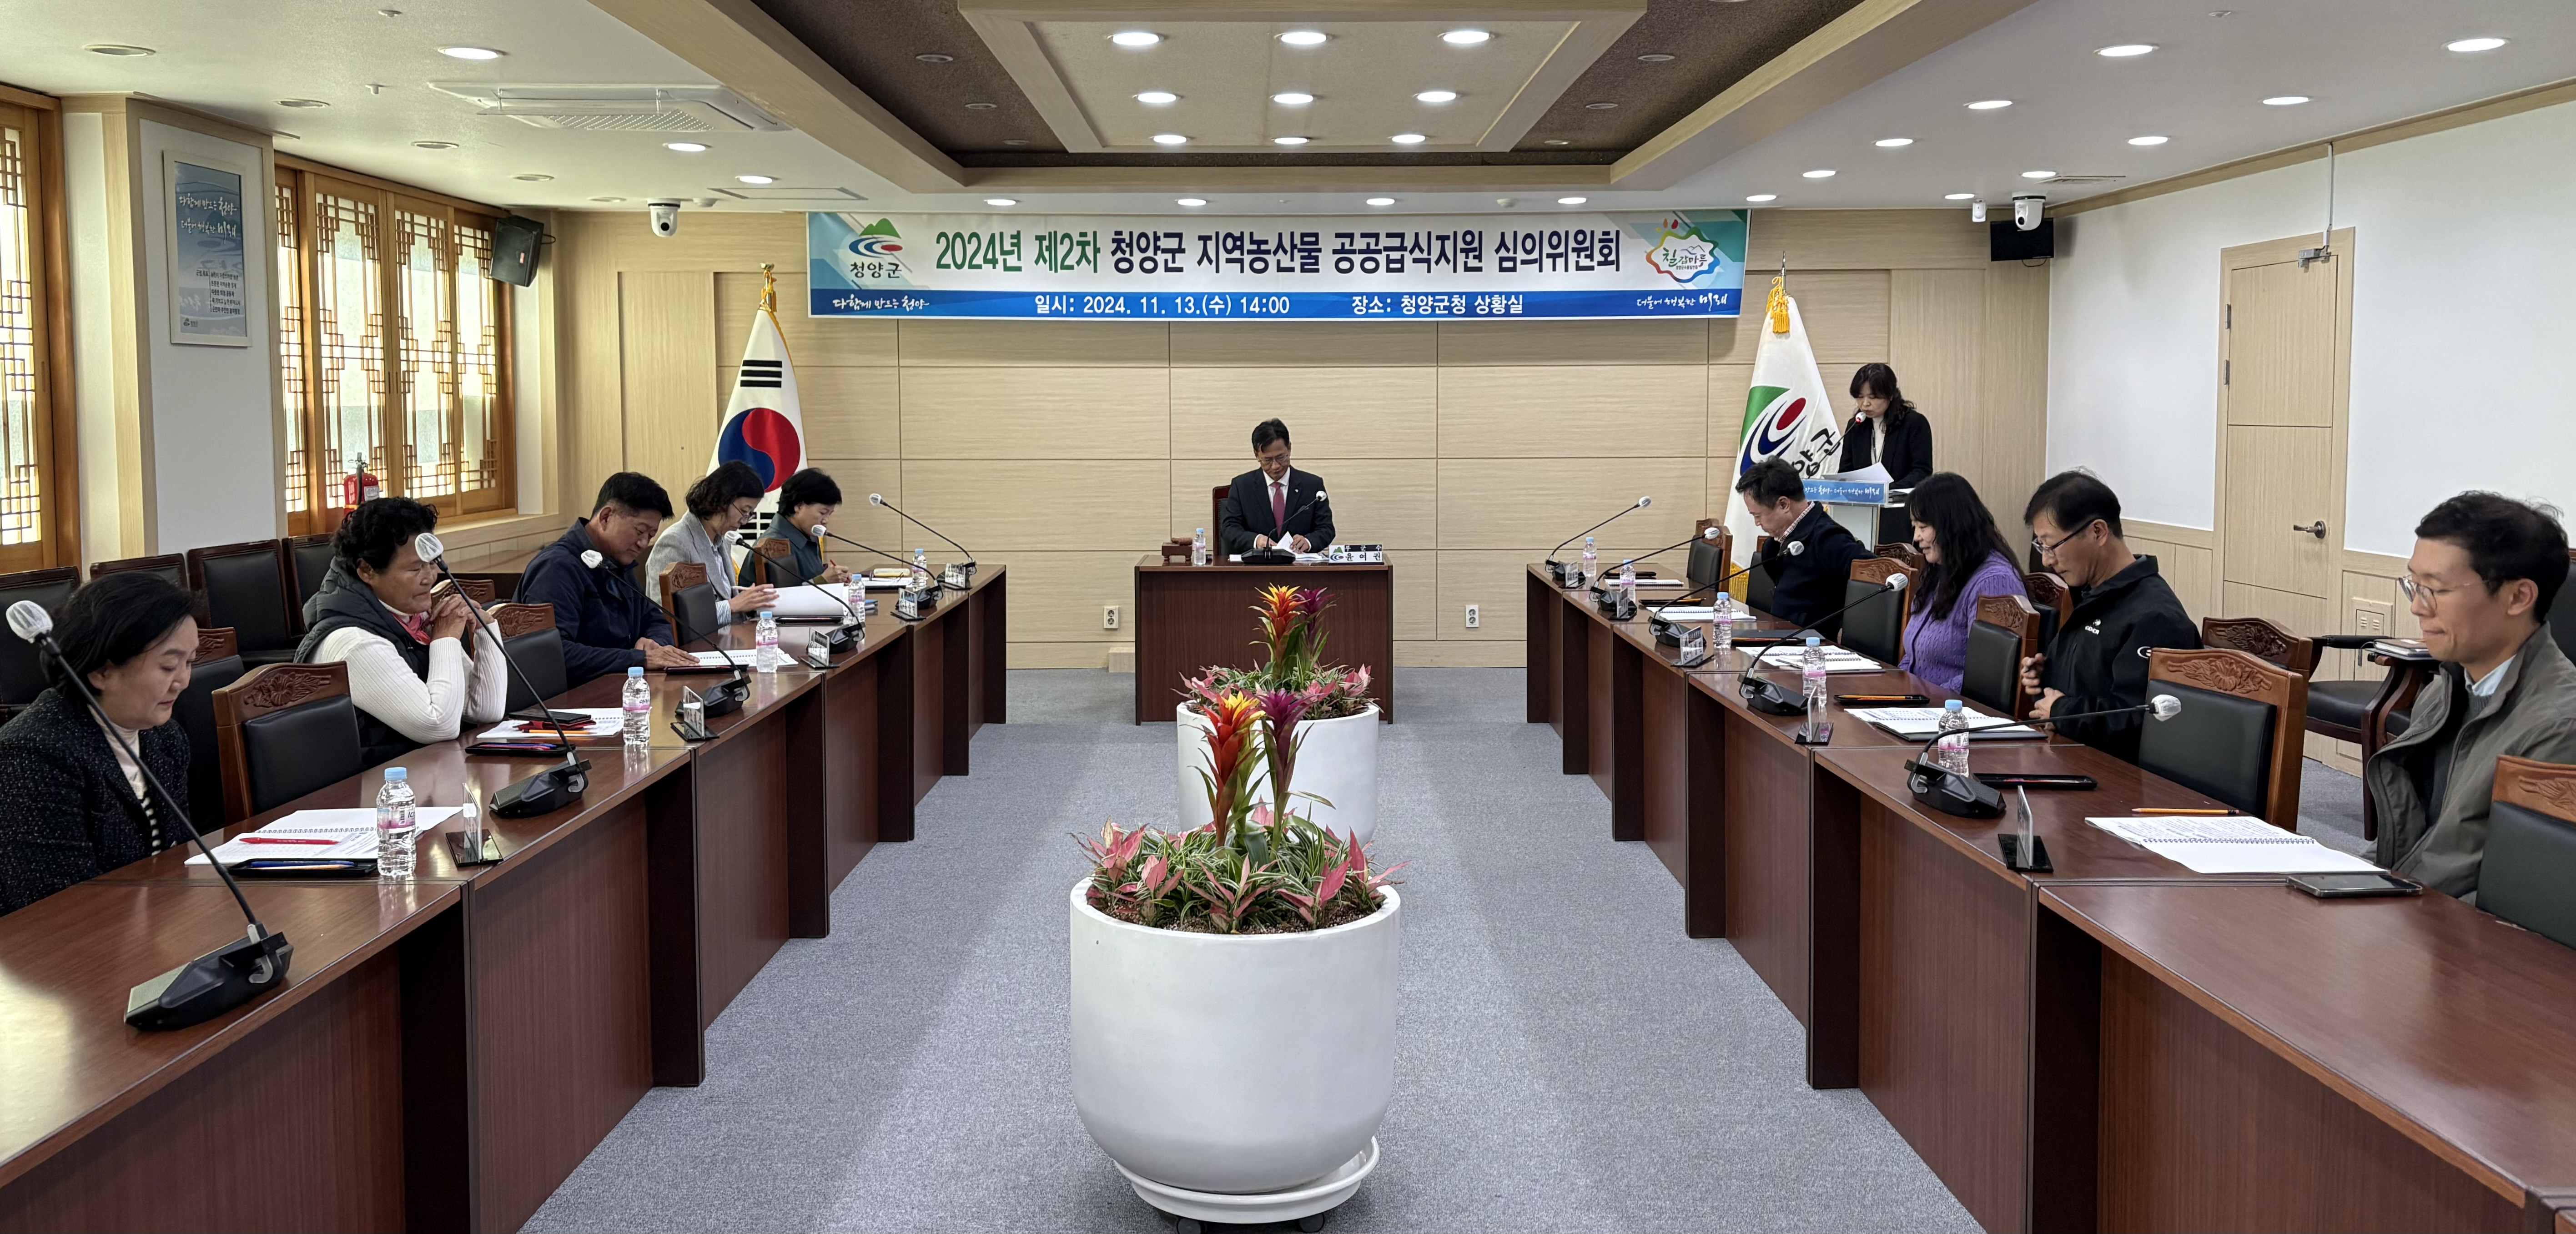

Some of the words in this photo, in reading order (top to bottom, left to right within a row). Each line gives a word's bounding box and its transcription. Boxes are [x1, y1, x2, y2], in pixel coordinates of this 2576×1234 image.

[202, 198, 217, 211] 만드는
[218, 196, 237, 217] 청양
[936, 230, 1022, 272] 2024년
[1034, 230, 1101, 273] 제2차
[1110, 230, 1186, 274] 청양군
[1196, 230, 1322, 274] 지역농산물
[1332, 229, 1484, 274] 공공급식지원
[1494, 229, 1620, 273] 심의위원회
[850, 262, 902, 278] 청양군
[833, 294, 871, 310] 다함께
[875, 298, 899, 309] 만드는
[901, 295, 930, 312] 청양
[1035, 295, 1074, 314] 일시:
[1084, 296, 1131, 314] 2024.
[1141, 297, 1165, 314] 11.
[1175, 294, 1231, 315] 13.(수)
[1240, 296, 1289, 313] 14:00
[1352, 295, 1391, 315] 장소:
[1401, 295, 1465, 314] 청양군청
[1474, 294, 1522, 314] 상황실
[1637, 295, 1662, 309] 더불어
[1664, 296, 1696, 308] 행복한
[1699, 292, 1728, 312] 미래
[1792, 428, 1841, 477] 양군
